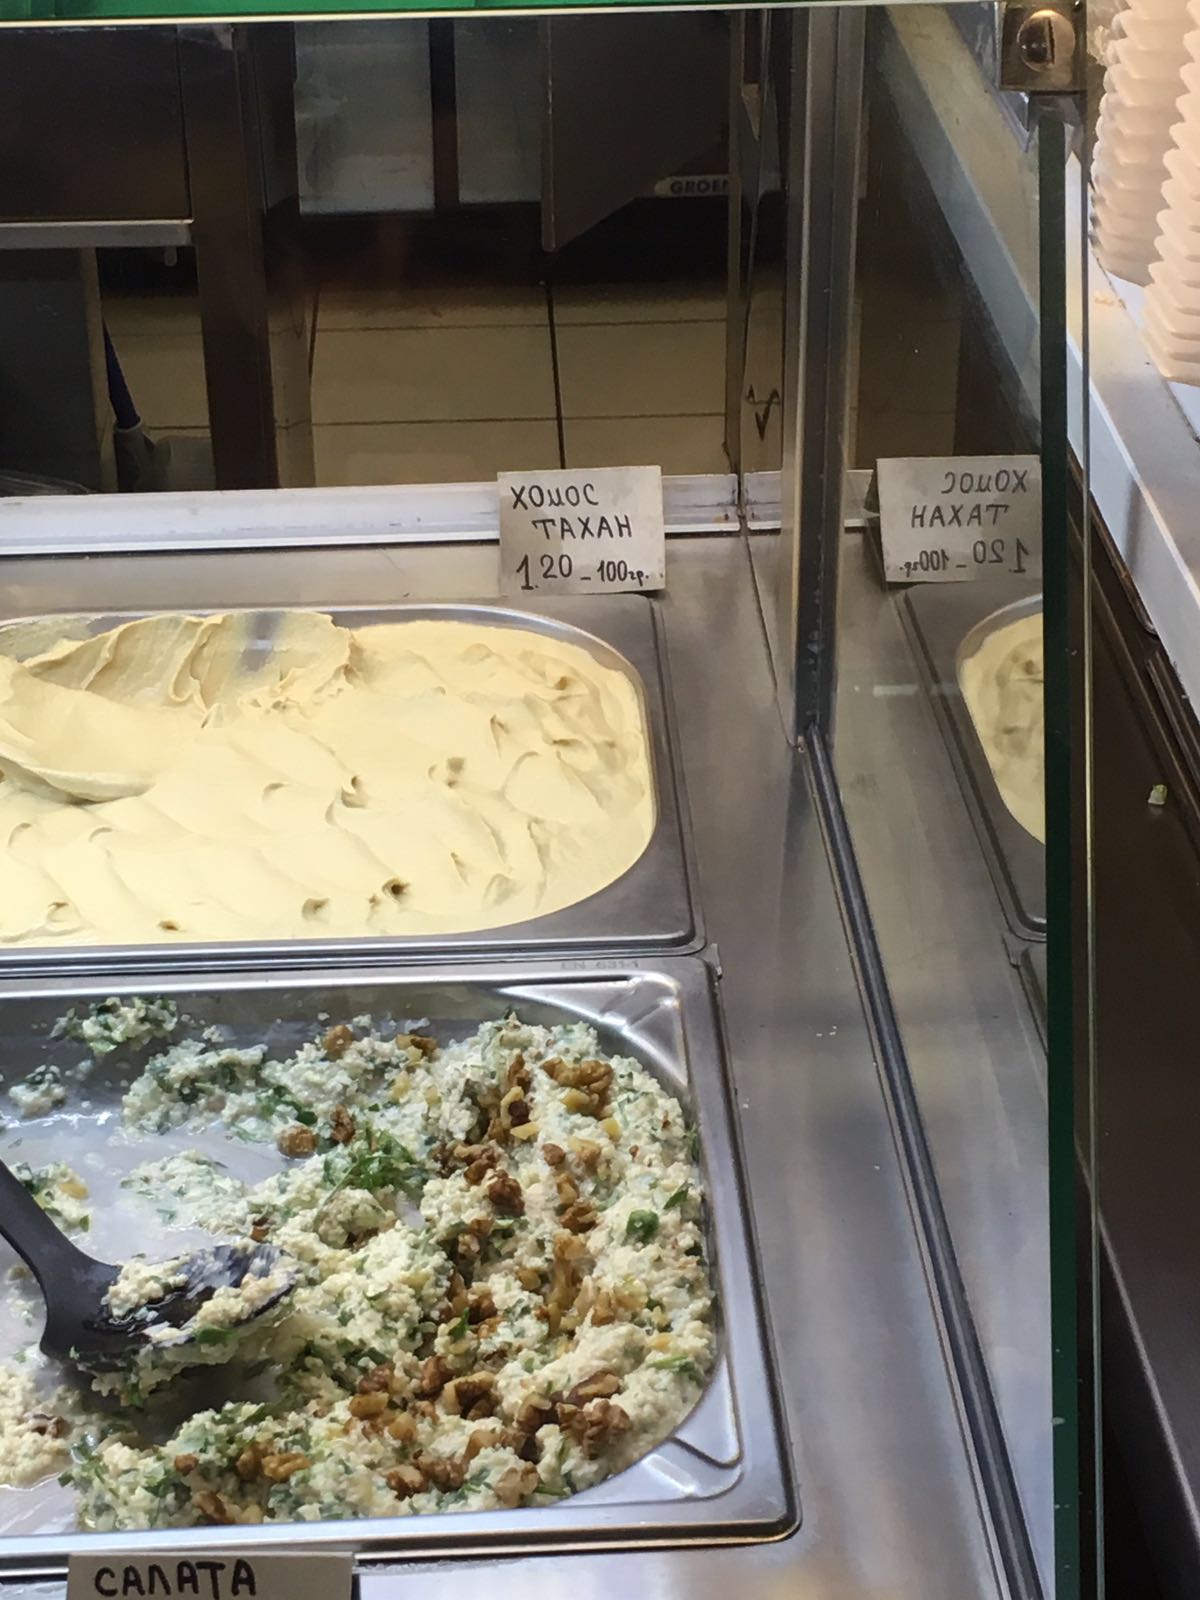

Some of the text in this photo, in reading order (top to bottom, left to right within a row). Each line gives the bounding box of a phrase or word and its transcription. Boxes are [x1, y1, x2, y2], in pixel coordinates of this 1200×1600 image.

[531, 515, 632, 540] ТАХАН
[516, 554, 572, 590] 1.20
[94, 1558, 256, 1600] САЛАТА
